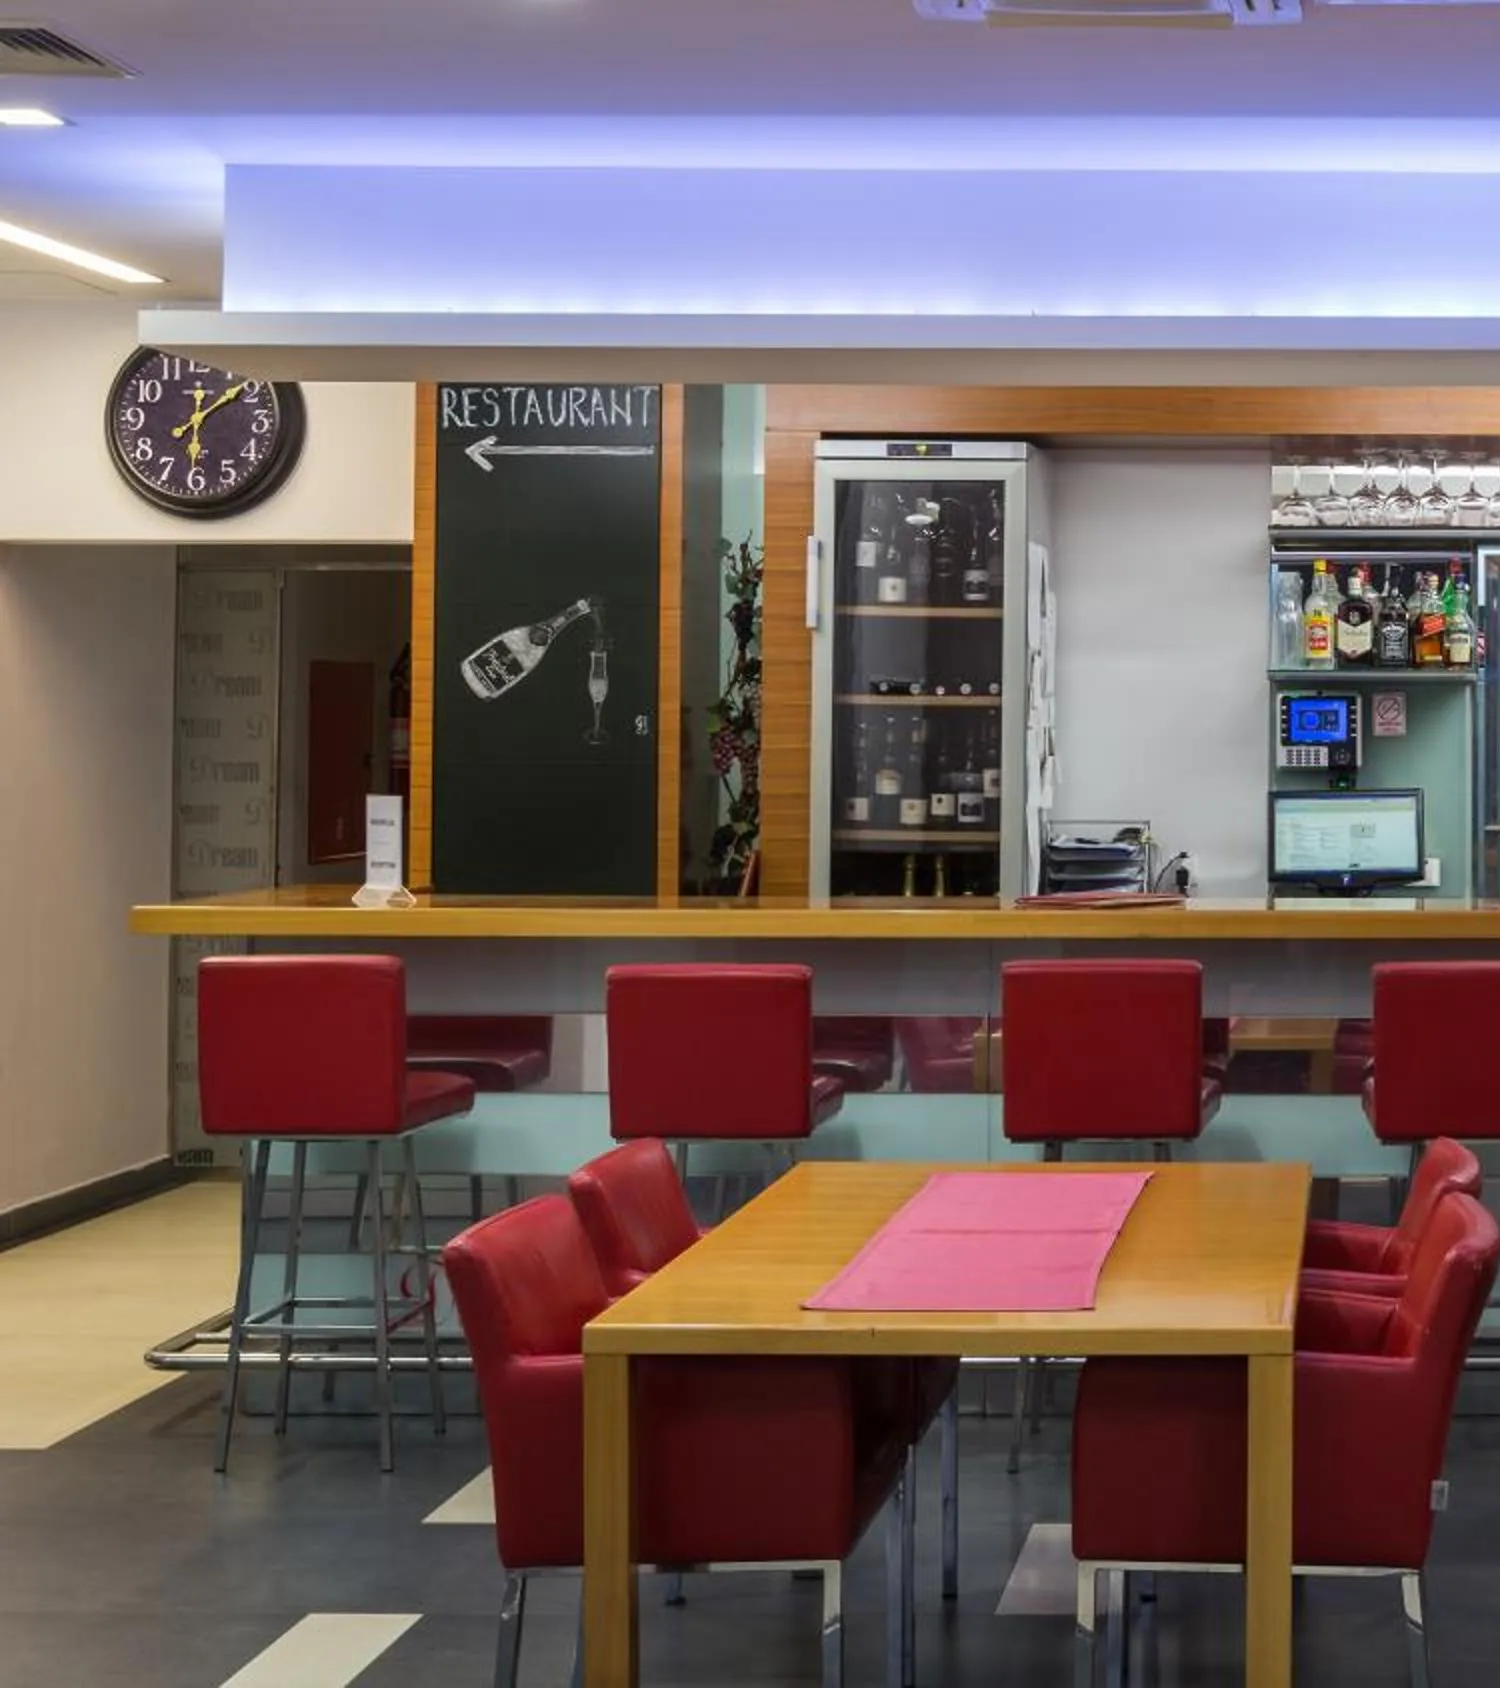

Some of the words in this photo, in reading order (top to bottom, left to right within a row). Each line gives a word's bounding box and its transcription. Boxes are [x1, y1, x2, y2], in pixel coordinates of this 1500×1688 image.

[138, 379, 163, 403] 10
[126, 407, 145, 431] 9
[441, 386, 660, 428] RESTAURANT
[251, 409, 269, 433] 3
[135, 437, 153, 461] 8
[239, 438, 257, 462] 4
[158, 456, 176, 486] 7
[186, 466, 206, 491] 6
[219, 459, 237, 486] 5
